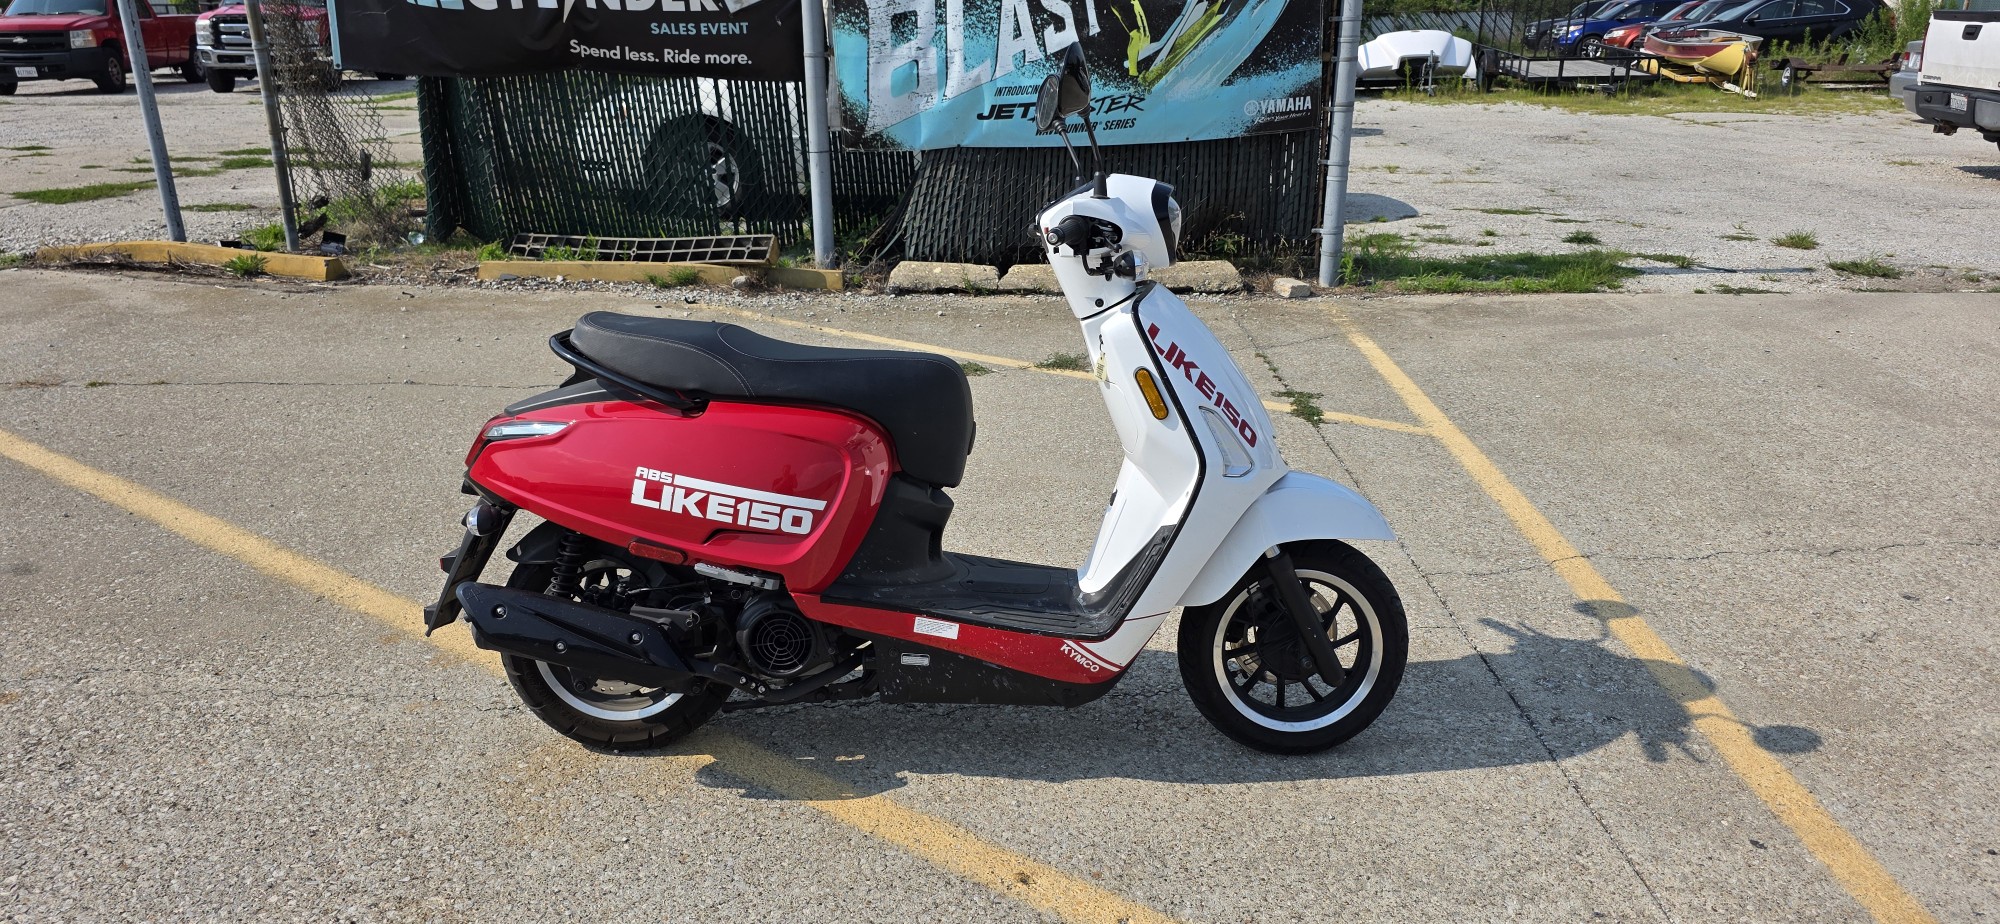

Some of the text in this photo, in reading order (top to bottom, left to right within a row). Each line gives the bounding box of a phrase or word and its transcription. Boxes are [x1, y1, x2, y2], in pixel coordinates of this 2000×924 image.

[650, 22, 749, 35] SALES EVENT
[569, 39, 752, 65] Spend less. Ride more.
[994, 84, 1040, 97] INTRODUCIN
[1260, 96, 1312, 115] YAMAHA
[1103, 118, 1137, 131] SERIES
[1147, 322, 1257, 448] LIKE150
[635, 466, 673, 484] ABS
[631, 479, 813, 535] LIKE150
[1060, 643, 1100, 672] KYMCO
